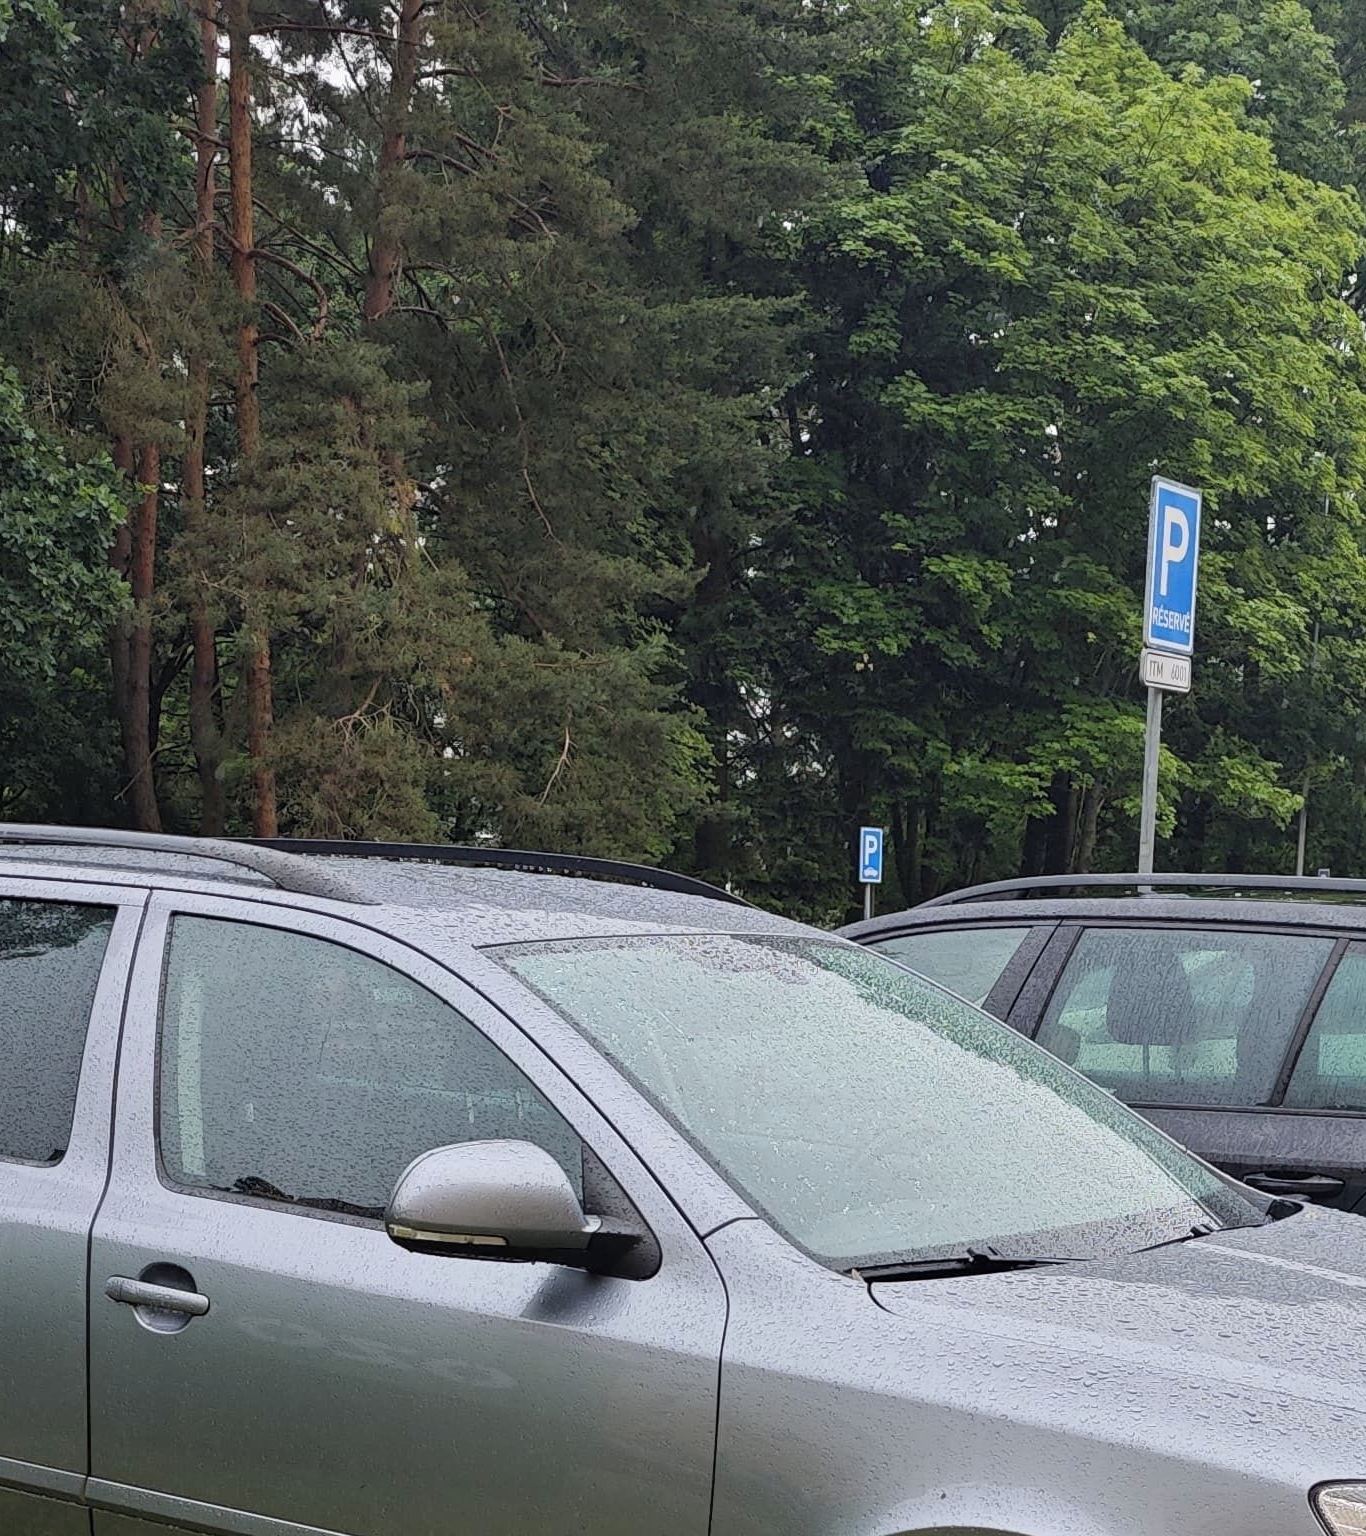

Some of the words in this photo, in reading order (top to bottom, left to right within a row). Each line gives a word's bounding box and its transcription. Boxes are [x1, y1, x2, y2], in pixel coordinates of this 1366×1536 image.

[1159, 505, 1190, 596] P
[1152, 604, 1191, 633] RÉSERVÉ
[865, 835, 878, 865] P
